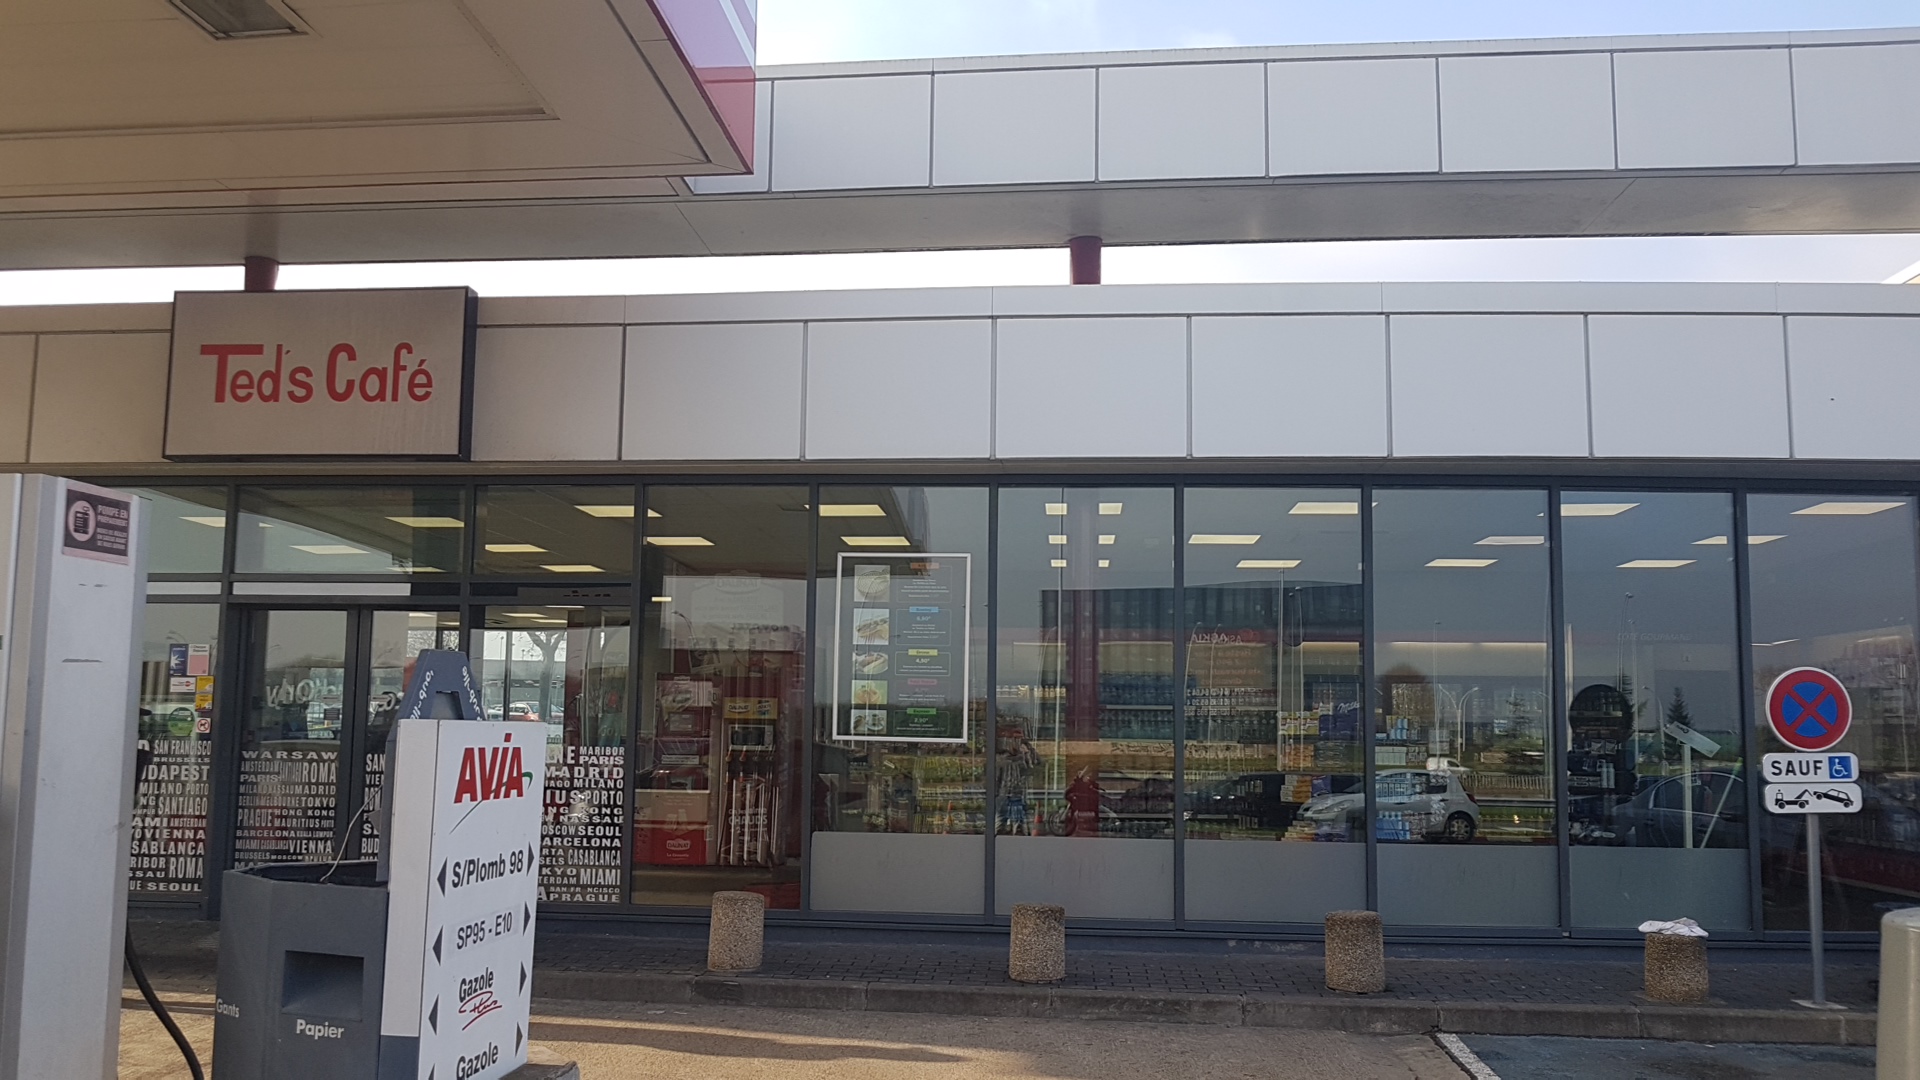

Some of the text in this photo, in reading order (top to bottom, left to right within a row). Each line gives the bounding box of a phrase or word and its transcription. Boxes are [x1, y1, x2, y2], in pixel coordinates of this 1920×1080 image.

[200, 342, 433, 403] Ted's Café
[154, 740, 170, 755] SAN
[170, 740, 212, 756] FRANCISCO
[241, 750, 338, 759] WARSAW
[579, 746, 625, 756] MARIBOR
[365, 753, 386, 772] SAN
[579, 756, 625, 765] PARIS
[241, 760, 280, 772] AMSTERDAM
[302, 761, 337, 783] ROMA
[545, 766, 625, 779] MADRID
[1771, 760, 1823, 776] SAUF
[240, 774, 280, 782] PARIS
[573, 778, 624, 789] MILANO
[139, 782, 210, 795] MILANO PORTO
[294, 785, 337, 795] MADRID
[300, 796, 336, 808] TOKYO
[584, 790, 624, 805] PORTO
[139, 795, 208, 816] NG SANTIAGO
[169, 817, 207, 828] AMSTERDAM
[237, 808, 335, 827] PRAGUE HONG KONG
[274, 818, 320, 828] MAURITIUS
[559, 814, 625, 823] NASSAU
[144, 828, 206, 839] VIENNA
[236, 829, 296, 838] BARCELONA
[542, 825, 622, 837] OSCOW SEOUL
[131, 840, 205, 856] SABLANCA
[235, 839, 260, 850] MIAMI
[289, 839, 333, 853] VIENNA
[542, 836, 622, 847] ARCELONA
[235, 851, 271, 860] BRUSSELS
[567, 849, 621, 866] CASABLANCA
[130, 856, 204, 879] RIBOR ROMA
[451, 849, 524, 889] S/Plomb 98
[541, 867, 621, 886] KYO MIAMI
[147, 881, 203, 892] SEOUL
[549, 893, 620, 902] PRAGUE
[456, 919, 486, 951] SP95
[494, 911, 513, 937] E10
[458, 966, 494, 1004] Gazole
[216, 998, 240, 1018] Gants
[295, 1018, 345, 1040] Papier
[456, 1041, 499, 1080] Gazole
